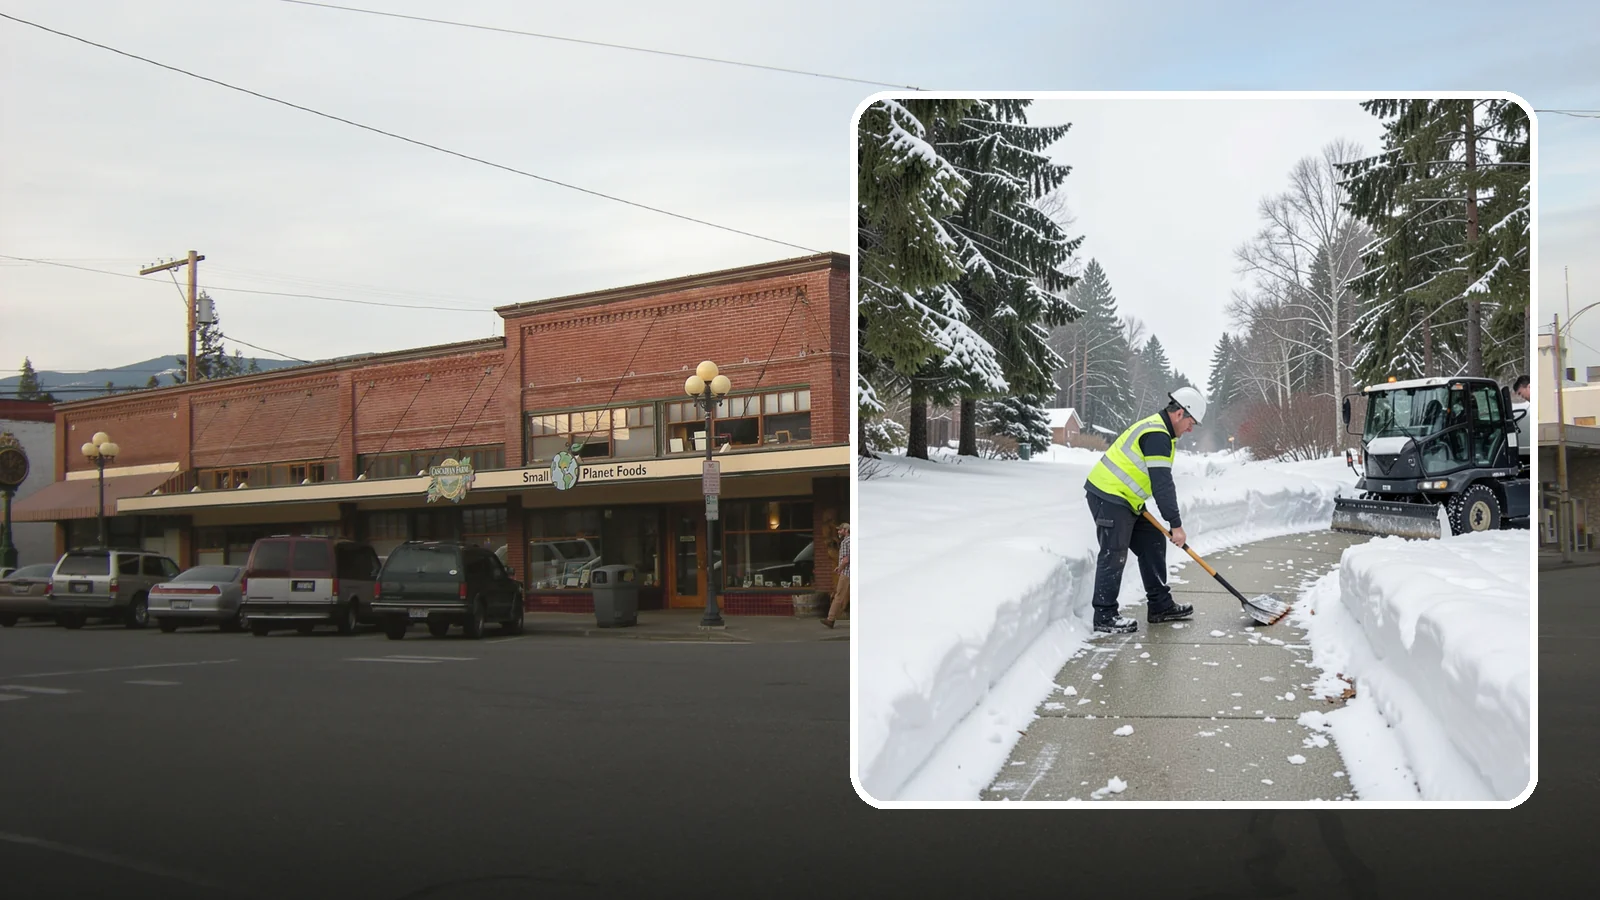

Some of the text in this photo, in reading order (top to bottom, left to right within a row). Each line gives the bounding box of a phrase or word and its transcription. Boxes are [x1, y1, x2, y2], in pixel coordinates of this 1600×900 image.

[523, 464, 647, 483] Small Planet Foods
